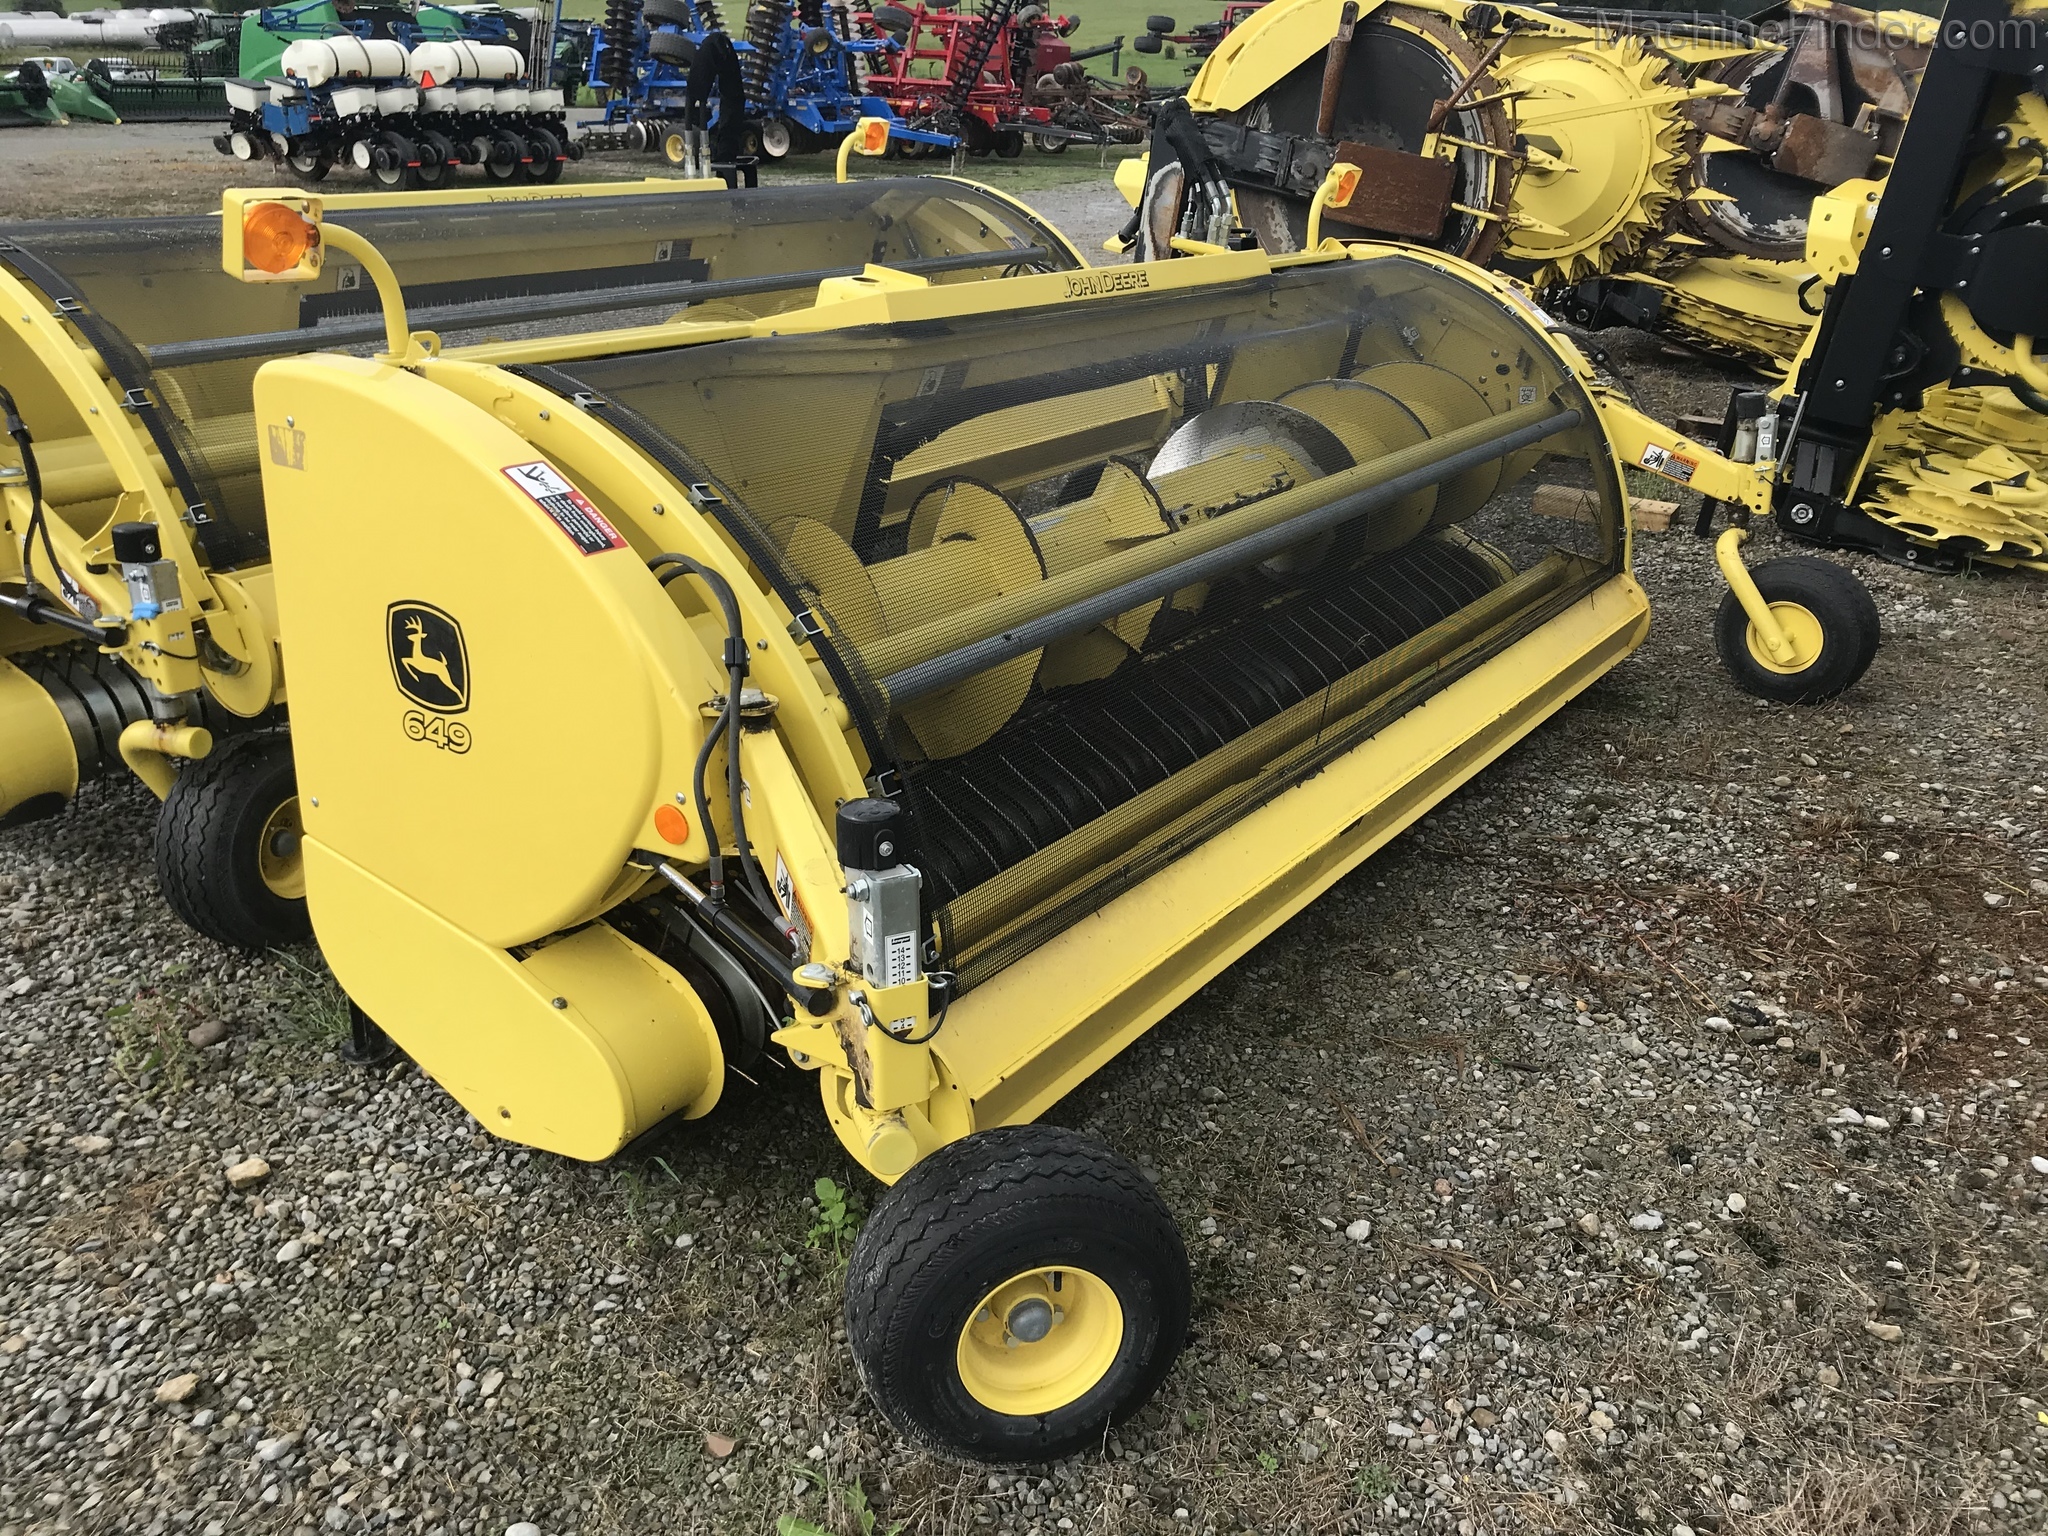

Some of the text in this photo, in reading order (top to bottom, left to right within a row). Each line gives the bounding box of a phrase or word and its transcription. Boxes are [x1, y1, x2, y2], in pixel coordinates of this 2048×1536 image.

[1063, 270, 1150, 298] JOHN DEERE
[584, 506, 618, 540] DANGER
[403, 709, 472, 755] 649
[897, 946, 905, 954] 14
[897, 954, 906, 962] 13
[897, 962, 906, 970] 12
